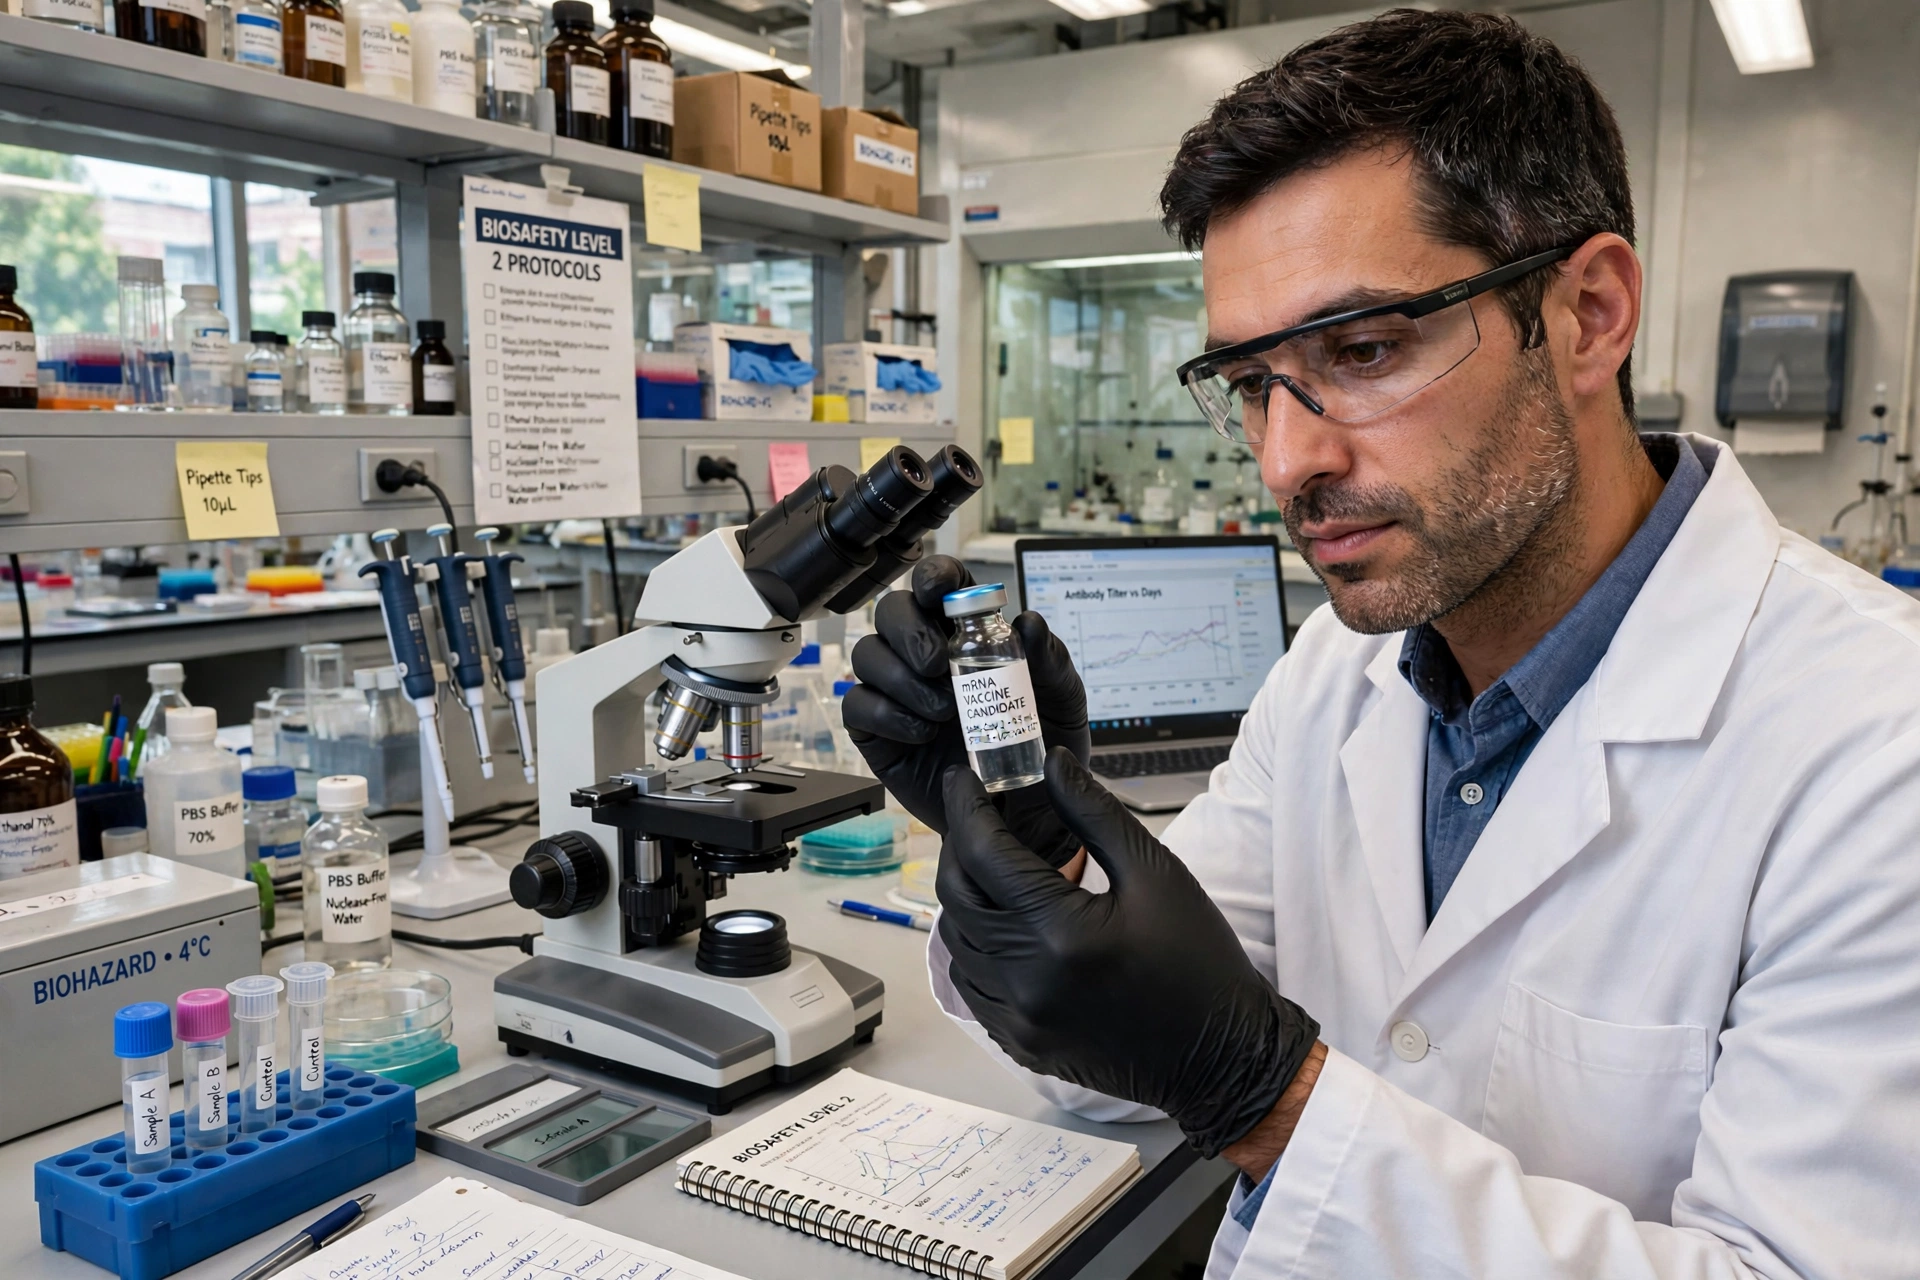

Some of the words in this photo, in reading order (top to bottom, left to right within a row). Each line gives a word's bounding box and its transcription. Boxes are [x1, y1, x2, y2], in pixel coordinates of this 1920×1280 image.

[750, 103, 787, 129] Pipette
[789, 114, 812, 137] Tips
[482, 217, 568, 248] BIOSAFETY
[571, 230, 616, 256] LEVEL
[492, 250, 502, 271] 2
[508, 253, 602, 283] PROTOCOLS
[186, 469, 233, 490] Pipette
[236, 468, 264, 488] Tips
[203, 496, 237, 516] 10µL
[1065, 588, 1105, 602] Antibody
[1107, 587, 1128, 599] Titer
[1130, 590, 1139, 598] vs
[1141, 587, 1162, 600] Days
[962, 676, 997, 693] mRNA
[963, 687, 1011, 706] VACCINE
[967, 696, 1027, 719] CANDIDATE
[181, 807, 206, 820] PBS
[210, 801, 239, 818] Buffer
[188, 829, 215, 844] 70%
[328, 874, 353, 887] PBS
[357, 869, 386, 886] Buffer
[332, 912, 364, 925] Water
[33, 950, 157, 1005] BIOHAZARD
[178, 934, 211, 962] 4°C
[206, 1066, 220, 1077] B
[140, 1088, 155, 1099] A
[207, 1082, 224, 1124] Sample
[142, 1105, 163, 1148] Sample
[732, 1122, 806, 1163] BIOSAFETY
[801, 1102, 846, 1123] LEVEL
[840, 1095, 856, 1103] 2
